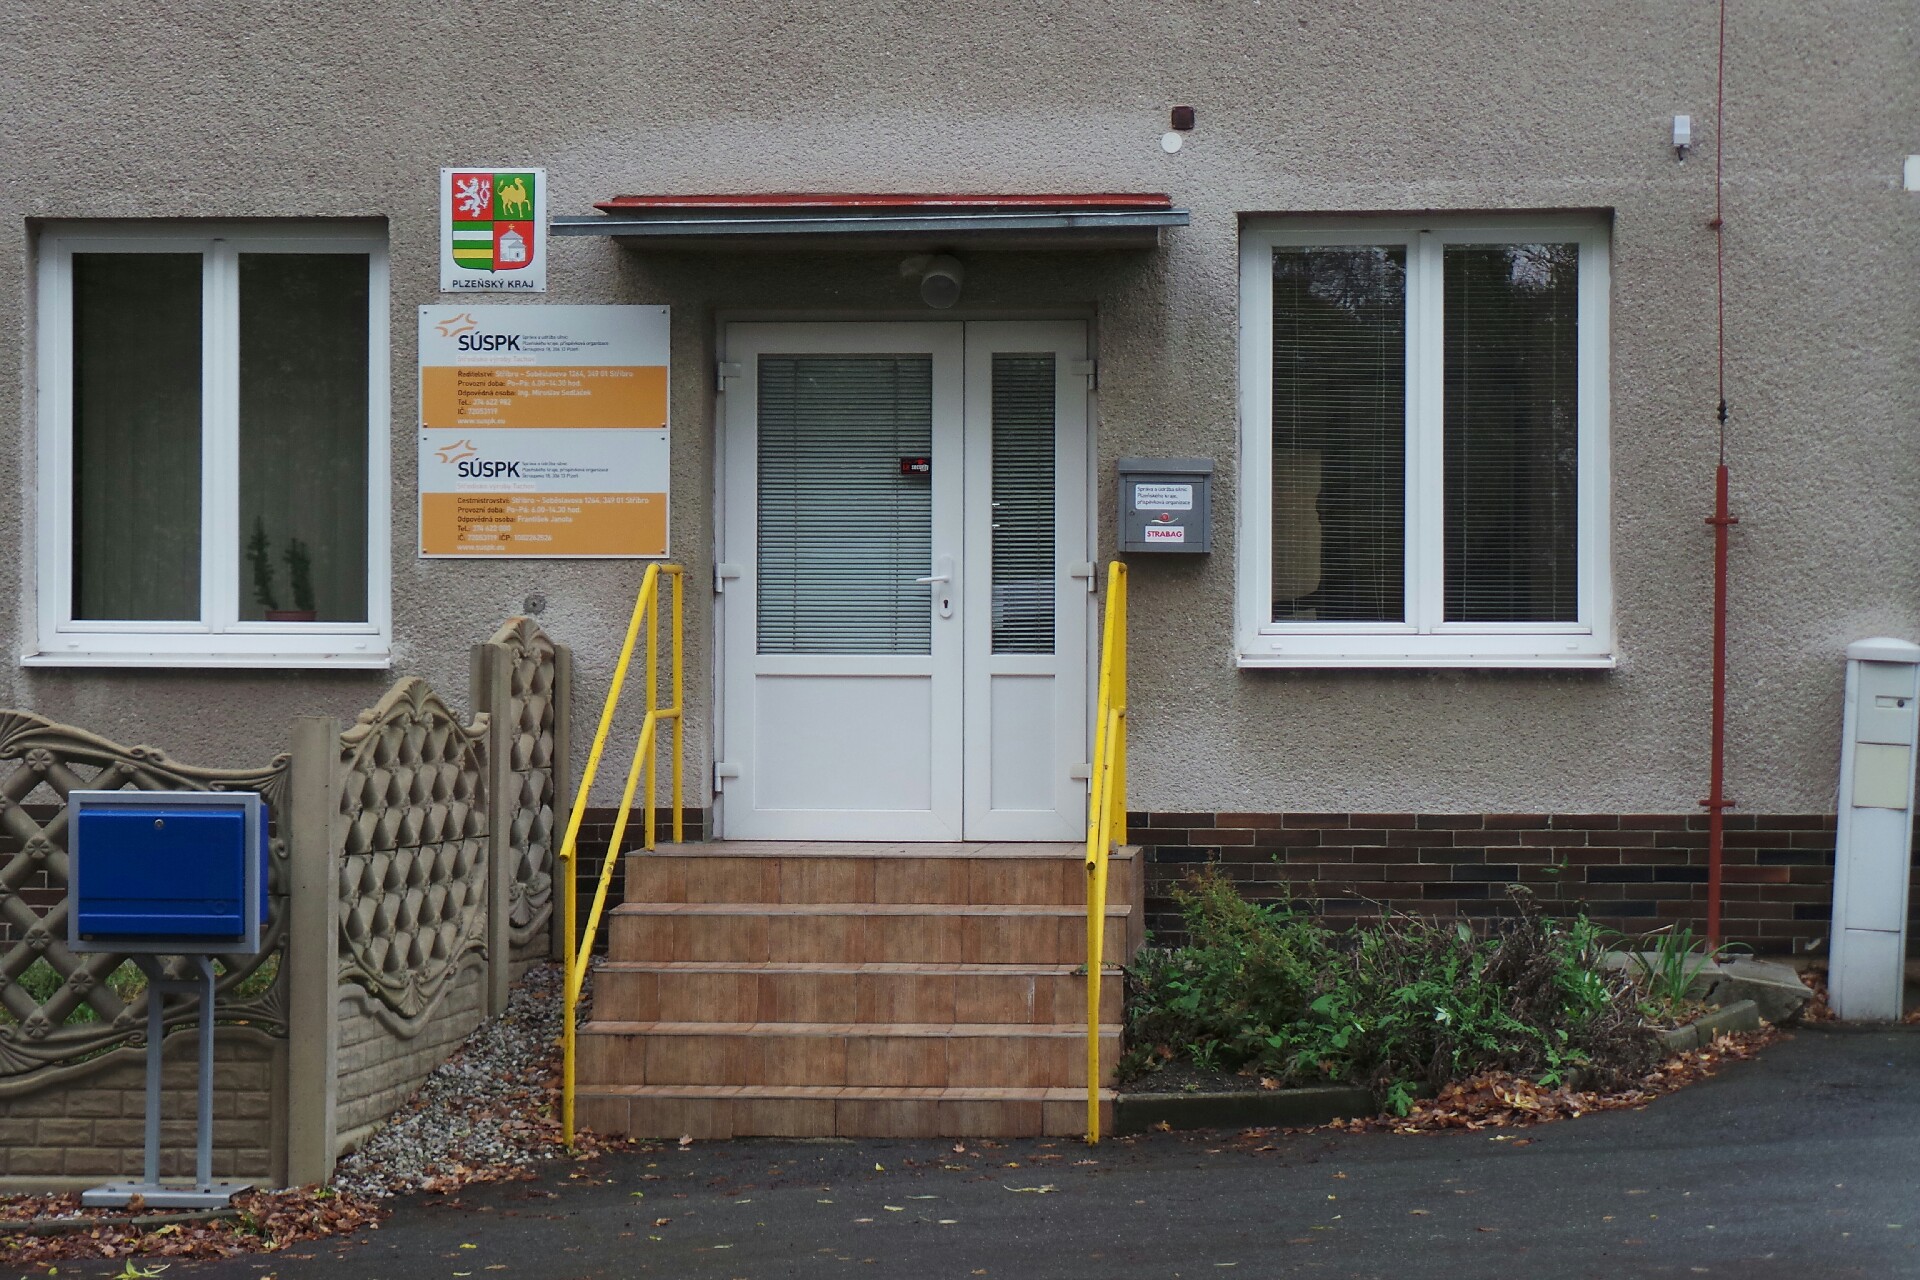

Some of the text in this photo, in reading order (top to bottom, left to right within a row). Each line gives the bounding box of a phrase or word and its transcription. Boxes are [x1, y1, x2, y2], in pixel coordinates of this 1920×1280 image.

[452, 278, 534, 288] PLZEŇSKÝ KRAJ
[458, 331, 520, 351] SÚSPK
[458, 457, 520, 478] SÚSPK
